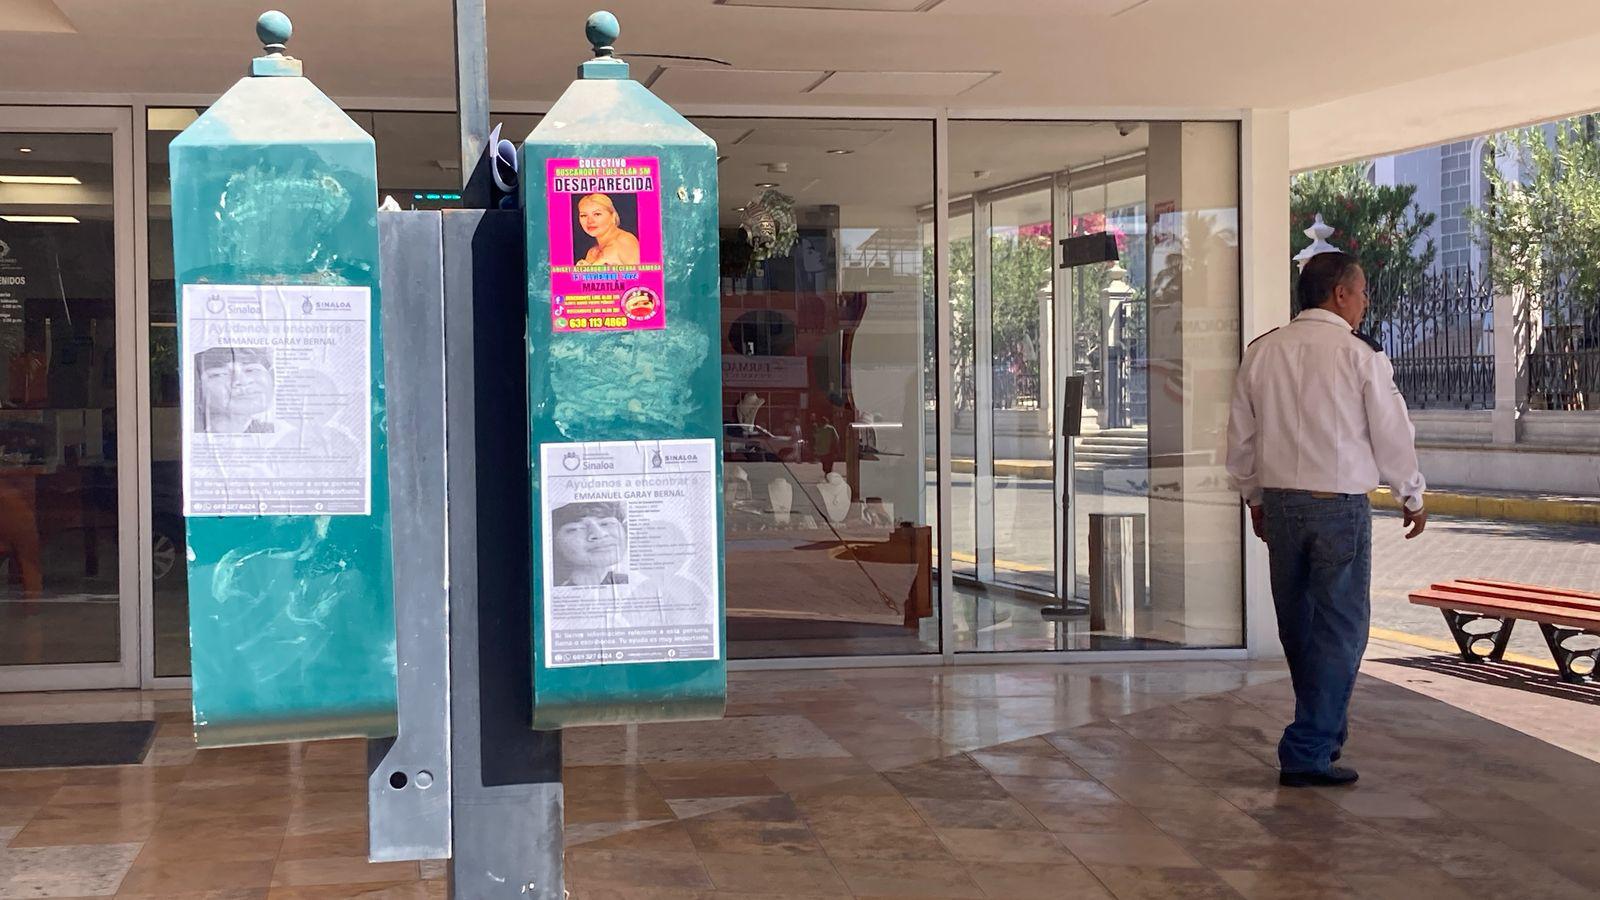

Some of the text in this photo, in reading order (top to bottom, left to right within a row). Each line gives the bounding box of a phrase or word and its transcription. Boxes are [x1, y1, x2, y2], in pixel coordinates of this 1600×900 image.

[579, 159, 626, 168] COLECTIVO
[554, 177, 653, 192] DESAPARECIDA
[582, 280, 625, 292] MAZATLÁN
[228, 305, 262, 314] Sinaloa
[218, 338, 336, 346] EMMANUEL GARAY BERNAL
[582, 460, 614, 470] Sinaloa
[635, 476, 688, 488] encontrar
[574, 490, 684, 500] EMMANUEL GARAY BERNAL
